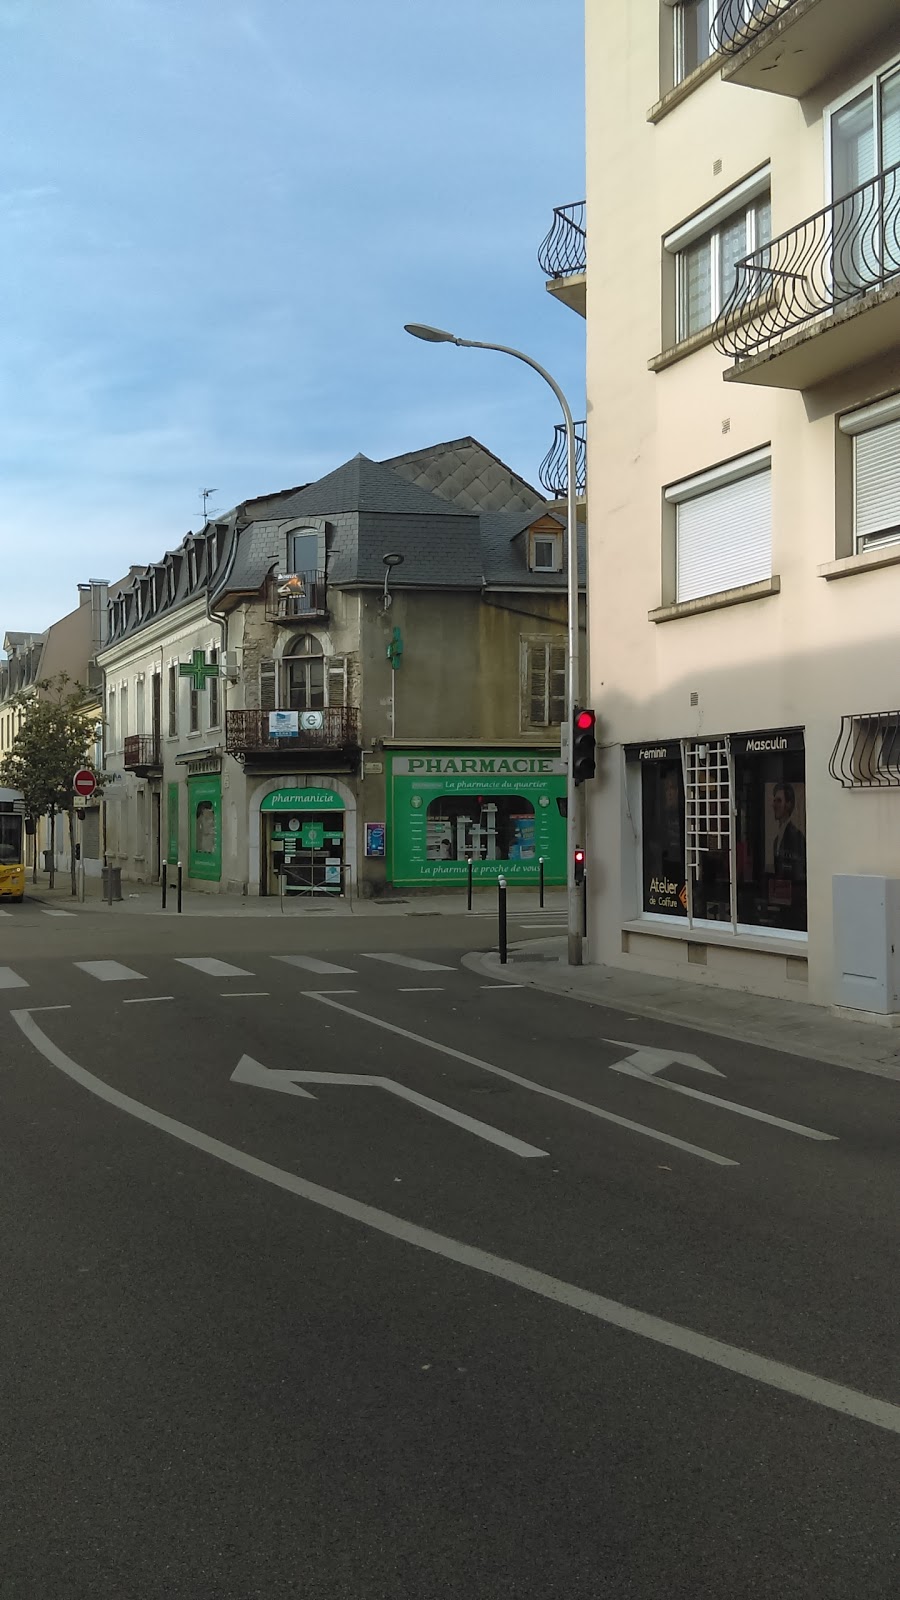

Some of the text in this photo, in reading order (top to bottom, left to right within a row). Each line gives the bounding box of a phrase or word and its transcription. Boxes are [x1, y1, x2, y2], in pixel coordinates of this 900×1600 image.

[746, 737, 787, 752] Masculin
[639, 747, 666, 759] Féminin
[407, 758, 554, 773] PHARMACIE
[456, 781, 501, 790] pharmacie
[514, 782, 547, 790] quartier
[272, 793, 333, 805] pharmanicia
[420, 866, 431, 874] La
[432, 865, 479, 876] pharmaie
[480, 864, 509, 875] proche
[650, 877, 678, 894] Atelier
[650, 897, 656, 905] de
